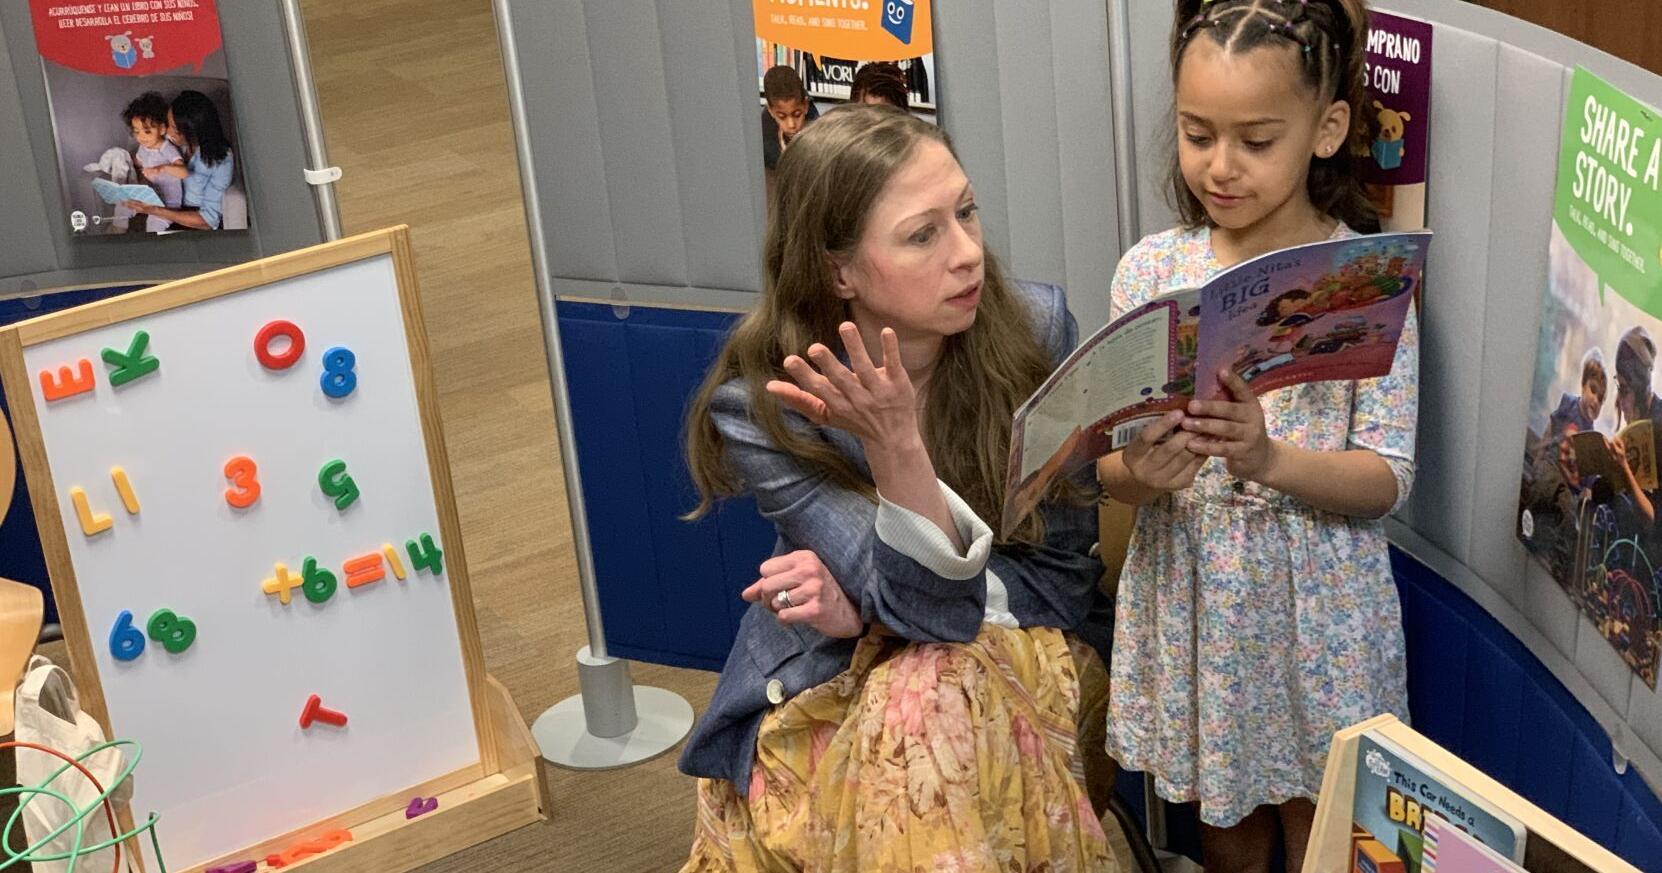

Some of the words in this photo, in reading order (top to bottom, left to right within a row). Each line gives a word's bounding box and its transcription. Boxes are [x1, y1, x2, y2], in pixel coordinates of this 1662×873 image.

[1366, 28, 1421, 65] MPRANO
[1373, 65, 1401, 94] CON
[1580, 95, 1644, 178] SHARE
[1643, 137, 1661, 191] A
[1572, 150, 1634, 237] STORY.
[1221, 277, 1270, 313] BIG
[320, 346, 358, 398] 8
[223, 456, 262, 508] 3
[1394, 770, 1417, 793] This
[1419, 783, 1437, 802] Car
[1438, 796, 1466, 820] Needs
[1468, 816, 1475, 828] a
